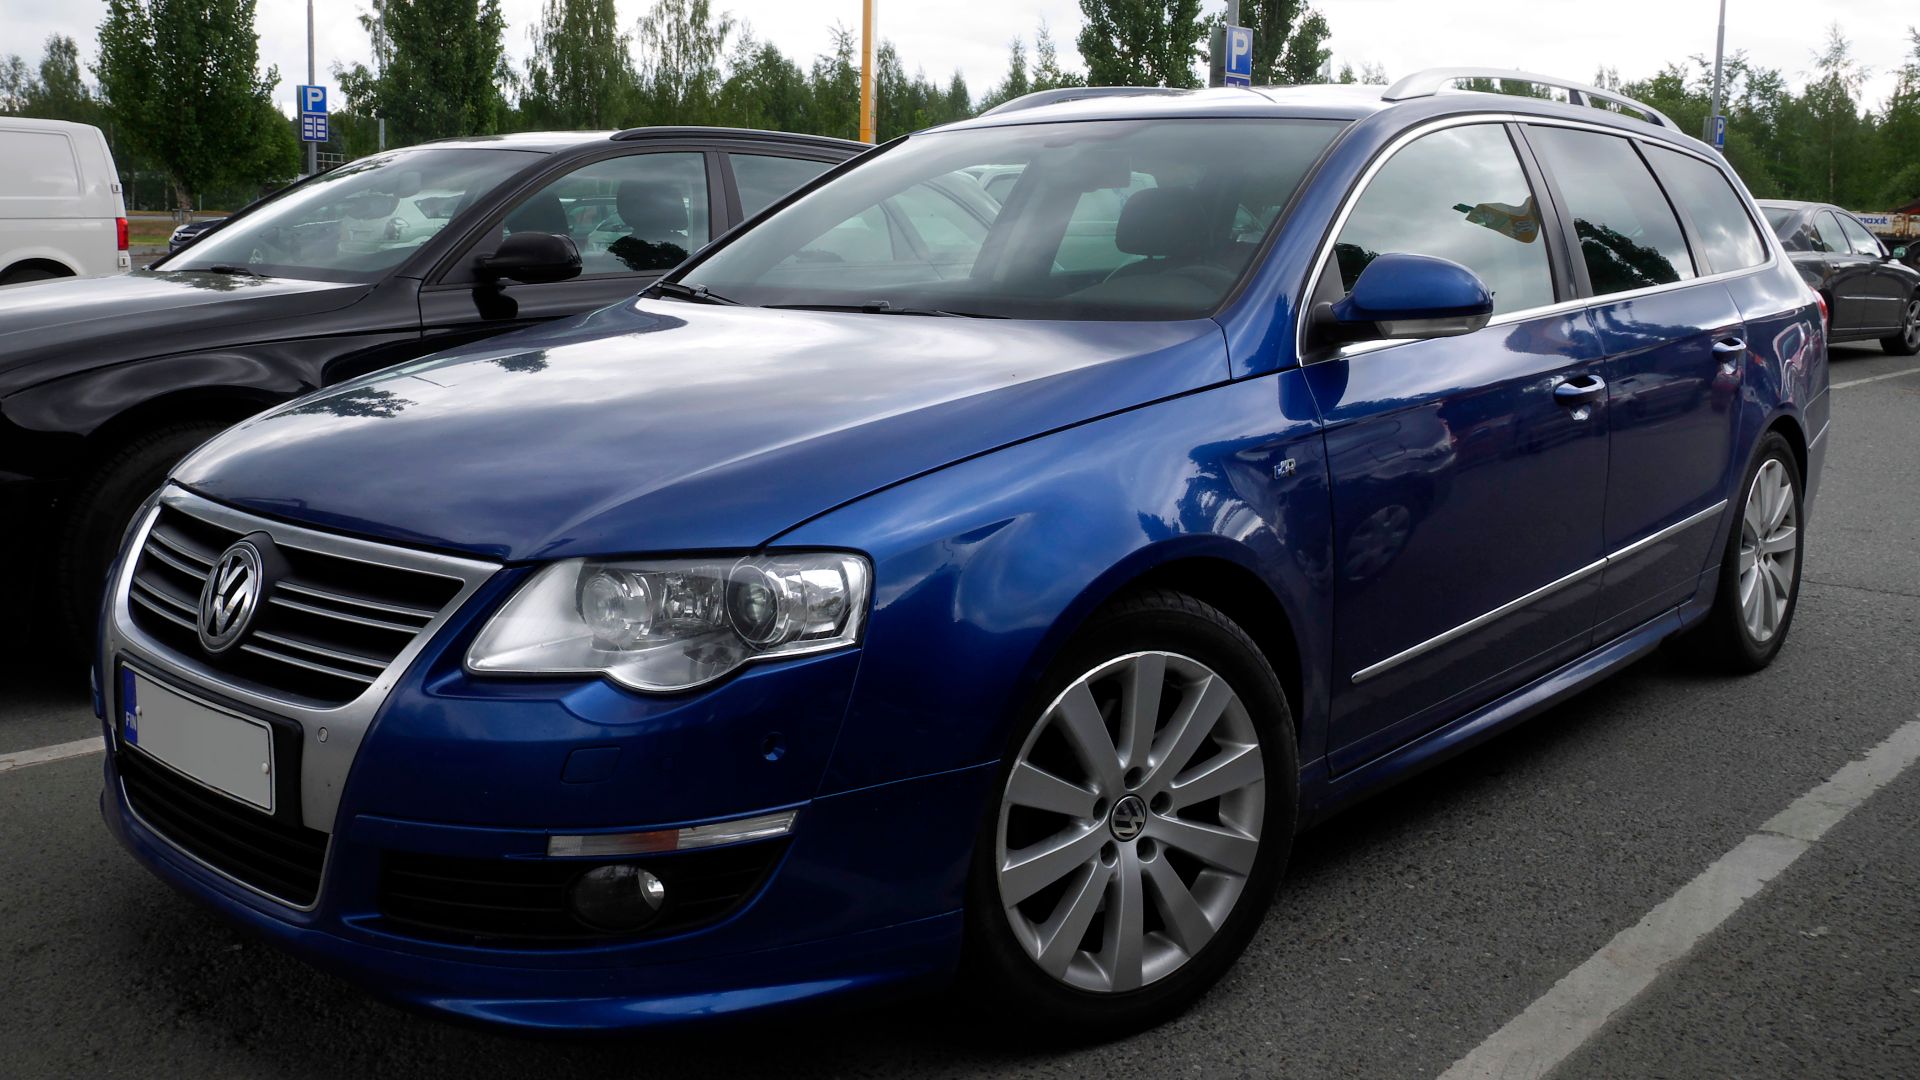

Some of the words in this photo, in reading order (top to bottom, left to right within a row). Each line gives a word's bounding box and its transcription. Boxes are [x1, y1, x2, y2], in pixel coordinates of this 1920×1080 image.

[1231, 31, 1249, 70] P
[307, 87, 323, 110] P
[125, 711, 137, 731] FIN
